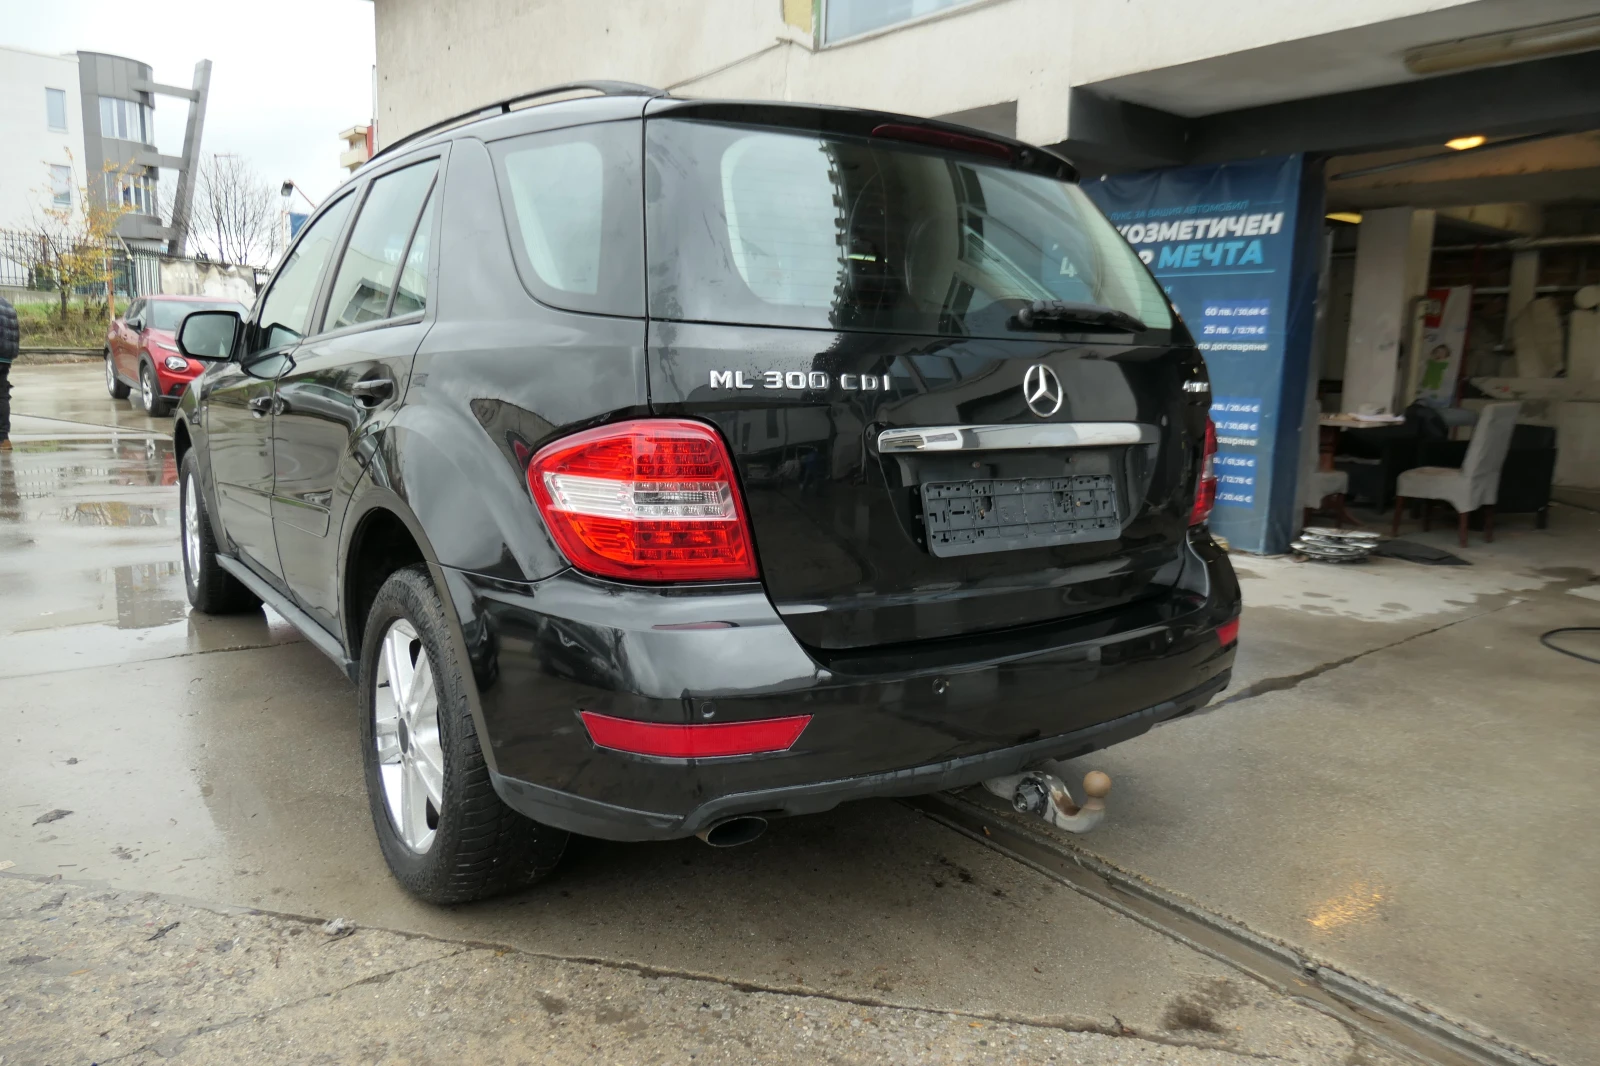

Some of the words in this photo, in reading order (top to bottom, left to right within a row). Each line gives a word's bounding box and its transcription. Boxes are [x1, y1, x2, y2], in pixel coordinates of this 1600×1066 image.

[1182, 199, 1250, 215] АВТОМОБИЛ
[1157, 239, 1264, 269] МЕЧТА
[1204, 306, 1217, 317] 60
[1203, 325, 1215, 335] 25
[1198, 342, 1210, 351] по
[1210, 342, 1268, 353] договаряне
[709, 369, 754, 390] ML
[763, 370, 829, 390] 300
[840, 373, 892, 392] CDI
